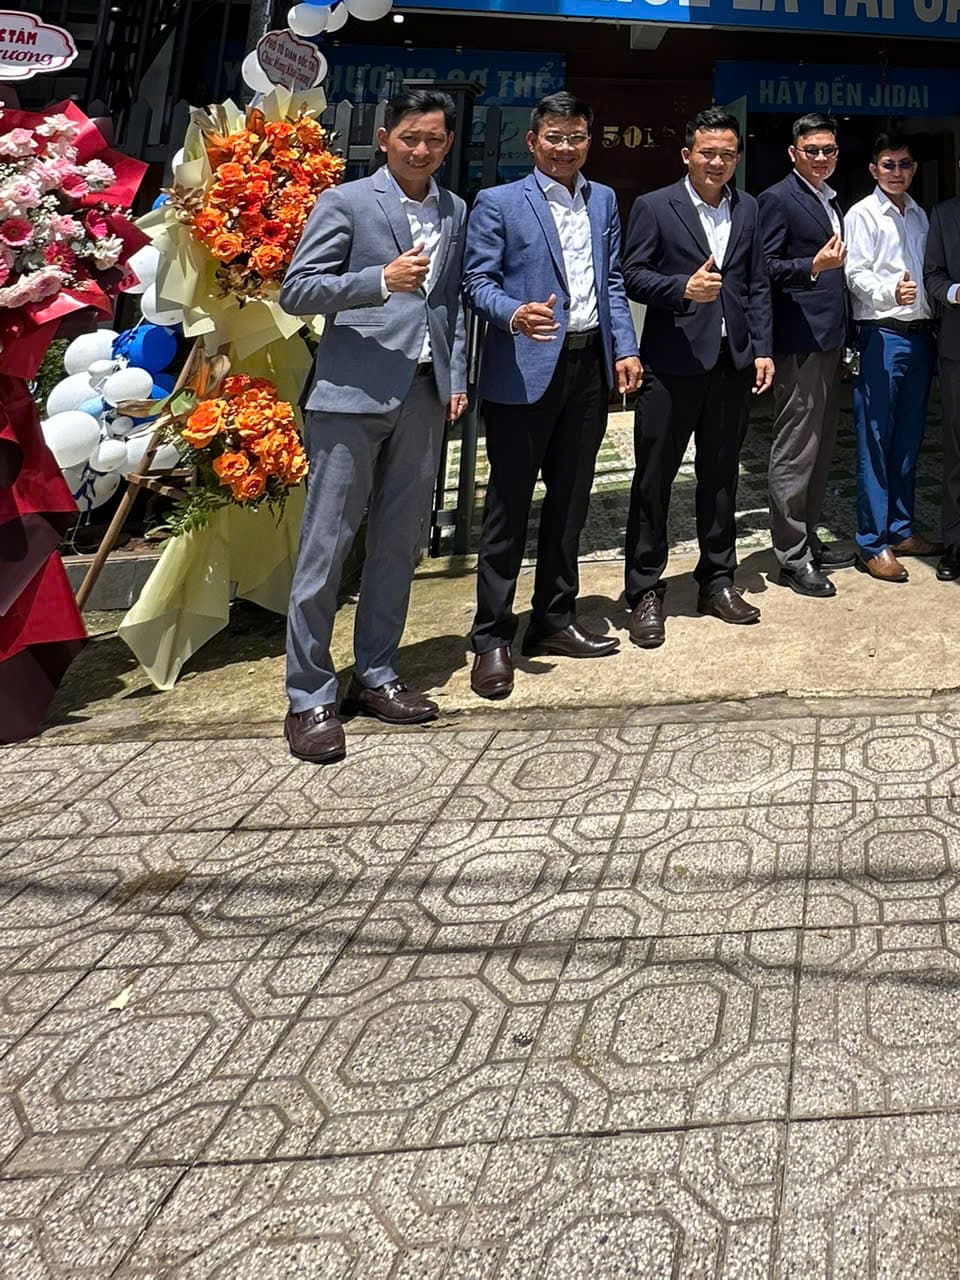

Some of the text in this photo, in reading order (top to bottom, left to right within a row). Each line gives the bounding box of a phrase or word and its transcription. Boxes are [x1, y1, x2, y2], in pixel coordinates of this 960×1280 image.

[759, 73, 929, 109] HÃY ĐẾN JIDAI
